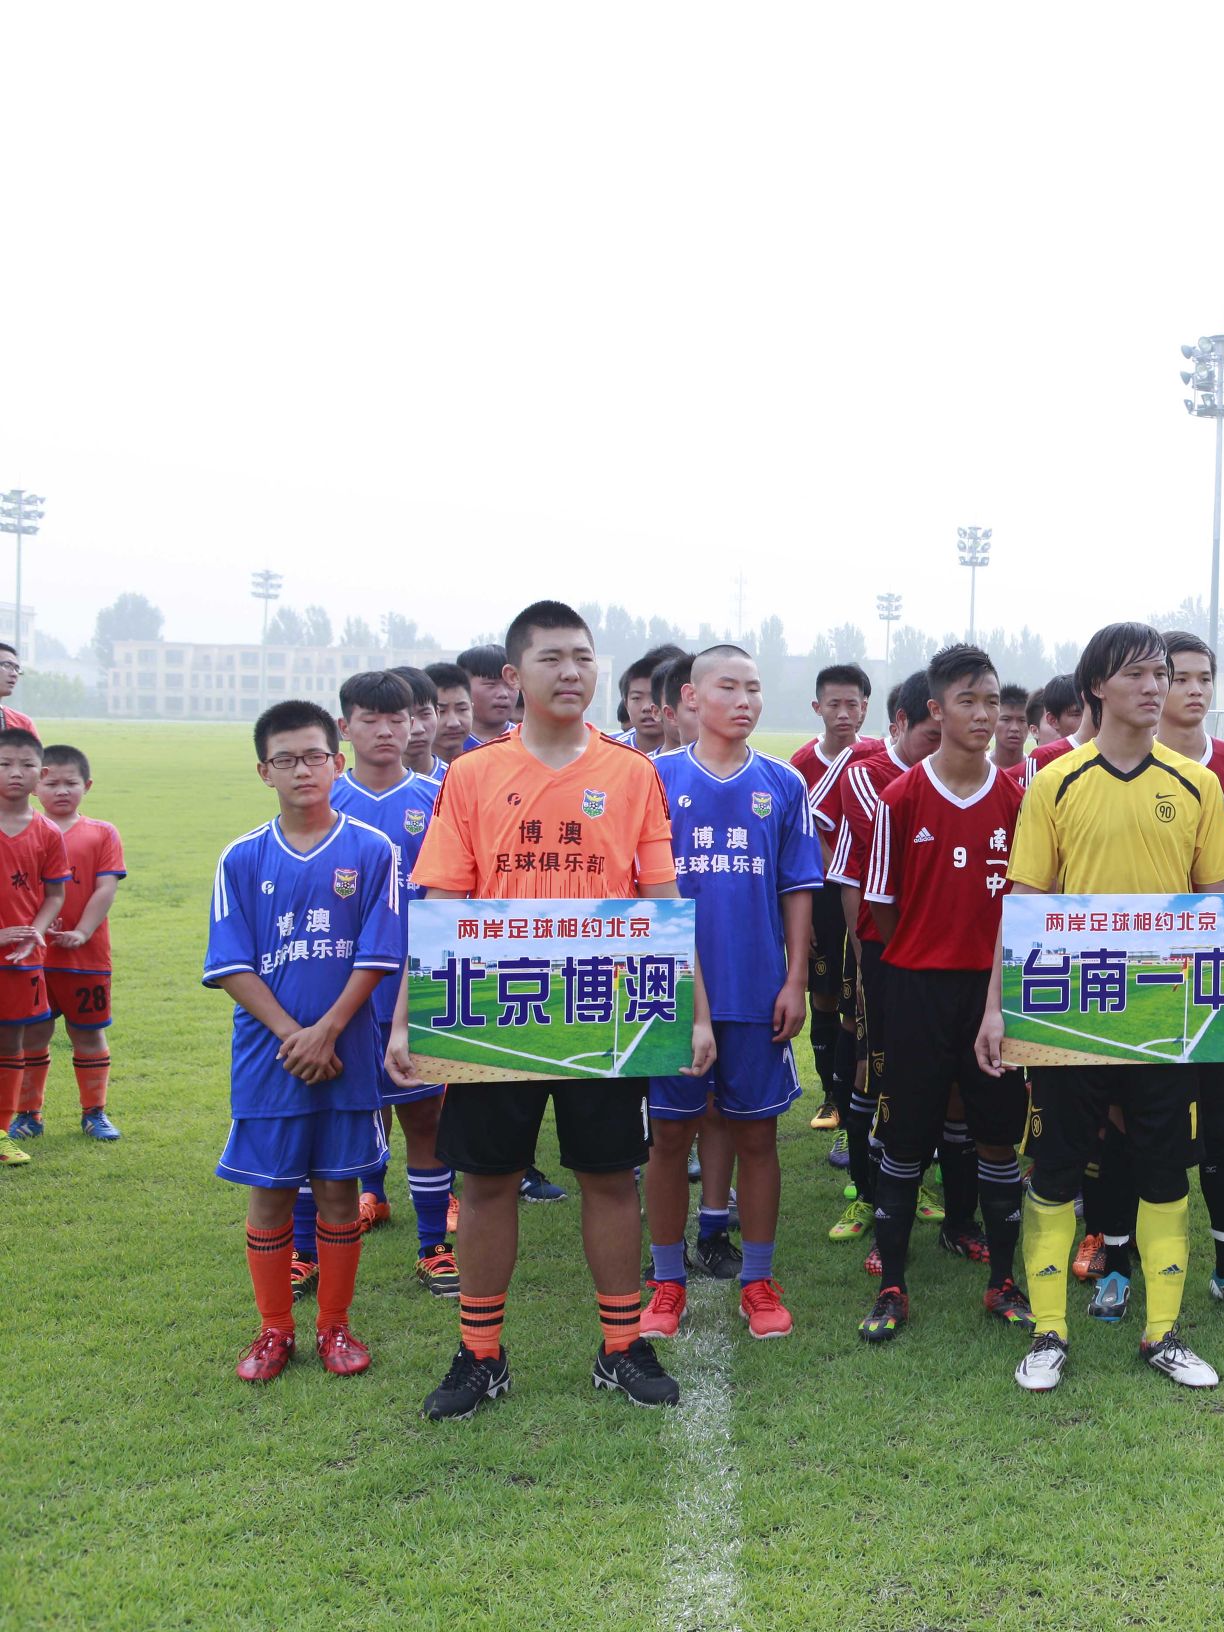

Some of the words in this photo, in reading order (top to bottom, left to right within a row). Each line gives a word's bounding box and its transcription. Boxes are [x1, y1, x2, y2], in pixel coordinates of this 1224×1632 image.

[1160, 806, 1172, 819] 90
[518, 819, 583, 845] 博澳
[692, 826, 749, 849] 博澳
[495, 851, 605, 875] 足球俱乐部
[674, 854, 766, 876] 足球俱乐部
[953, 846, 967, 868] 9
[985, 827, 1008, 898] 南一中
[276, 907, 331, 940] 博澳
[457, 917, 651, 939] 两岸足球相约北京
[1045, 911, 1217, 932] 两岸足球相约北京
[75, 985, 108, 1013] 28
[430, 954, 677, 1028] 北京博澳
